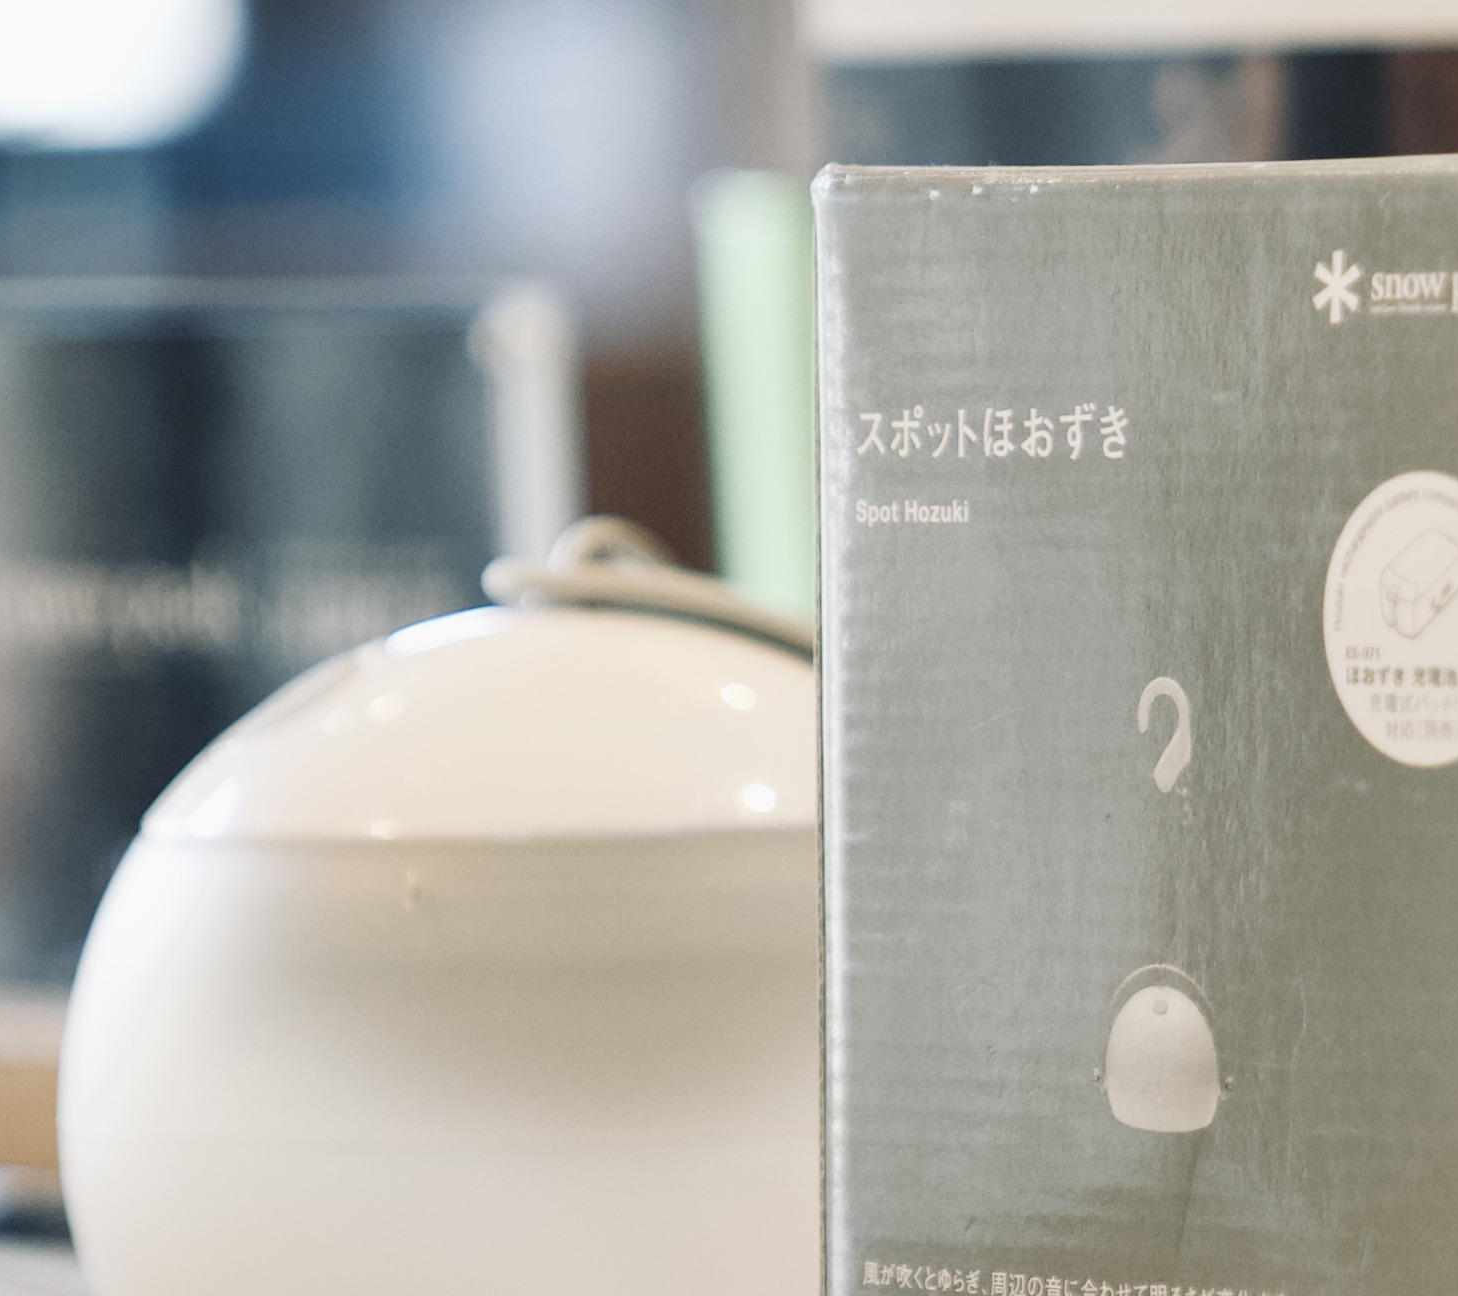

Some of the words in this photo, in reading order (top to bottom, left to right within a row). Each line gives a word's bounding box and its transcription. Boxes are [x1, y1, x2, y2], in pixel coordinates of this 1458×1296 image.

[1370, 271, 1446, 302] snow
[856, 402, 1130, 461] スポットほおずき
[855, 499, 898, 527] Spot
[903, 499, 970, 523] Hozuki
[1345, 665, 1404, 687] ほおずき
